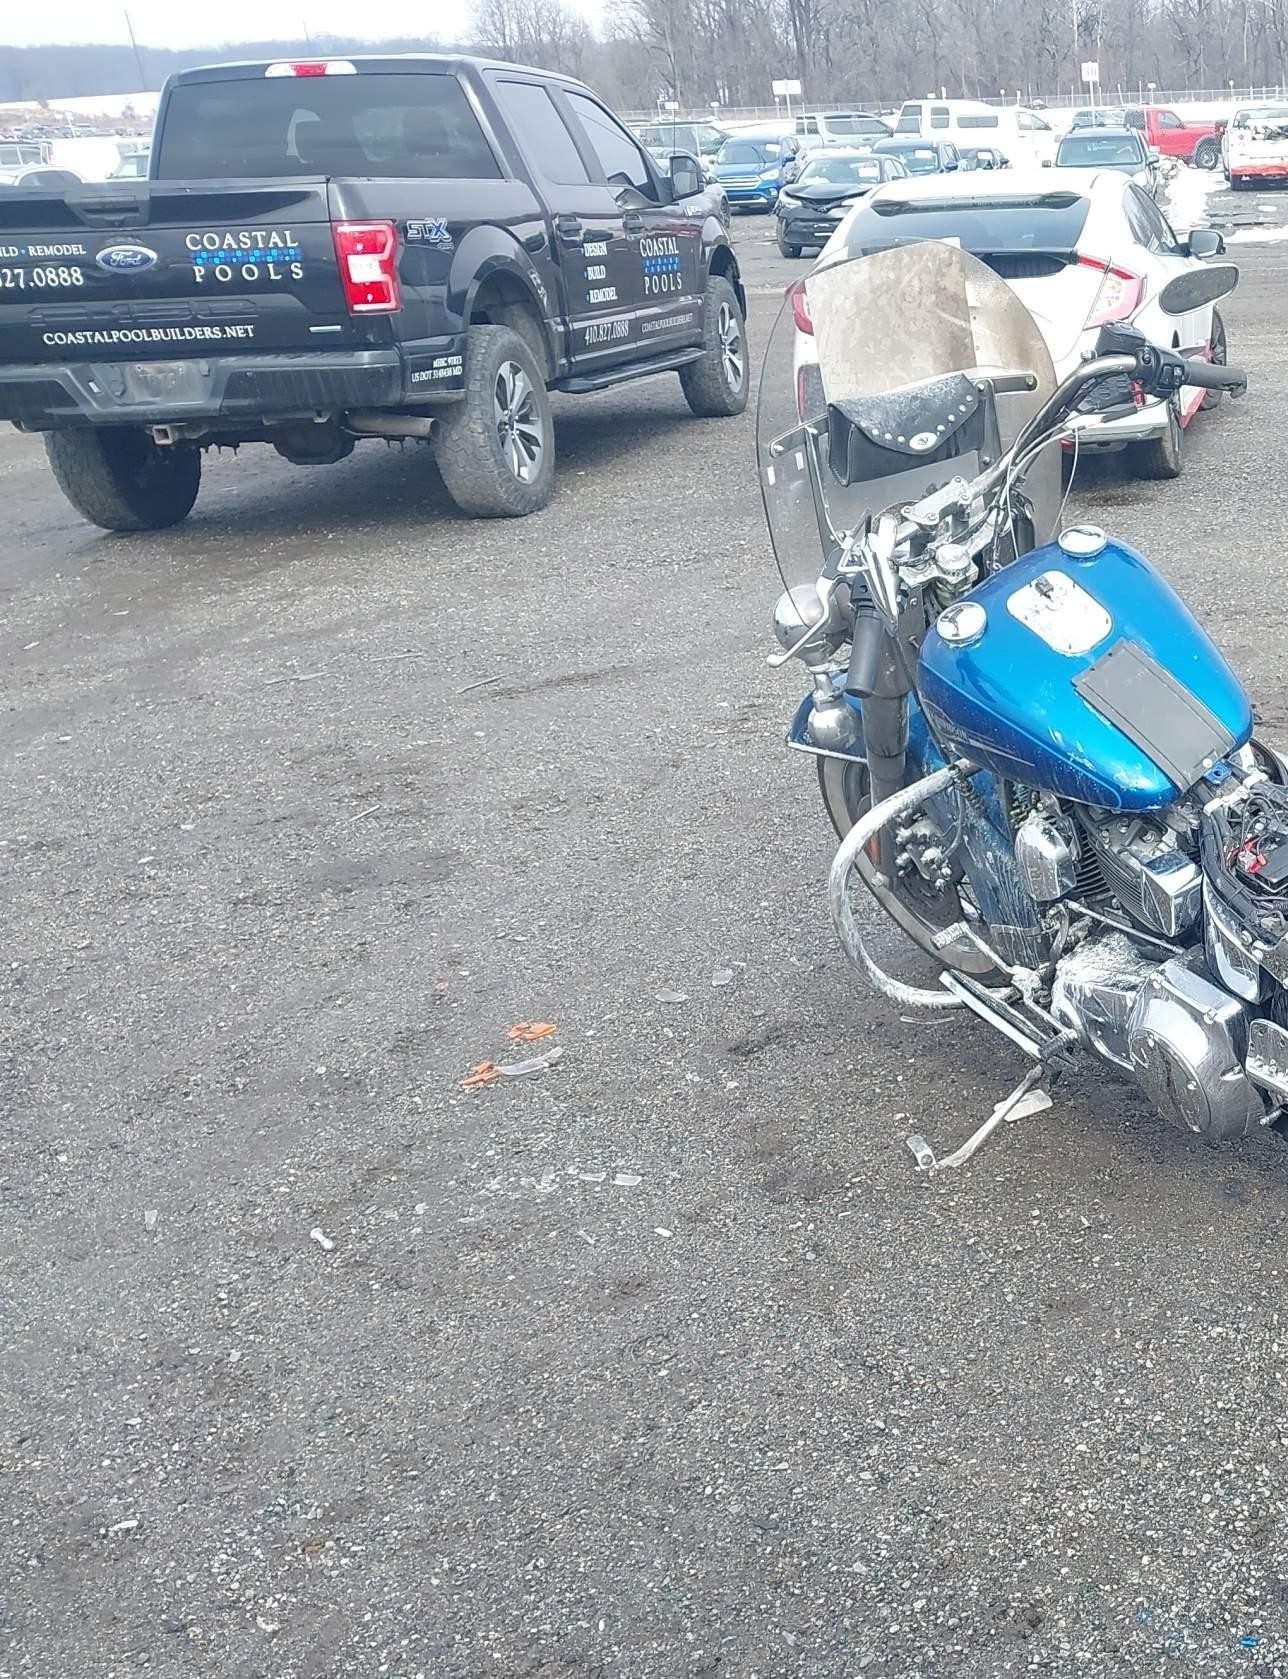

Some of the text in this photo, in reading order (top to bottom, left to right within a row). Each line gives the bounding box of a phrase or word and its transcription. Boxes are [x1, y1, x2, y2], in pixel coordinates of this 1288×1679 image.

[407, 217, 453, 242] STX
[185, 230, 299, 250] COASTAL
[583, 241, 608, 257] DESIGN
[640, 236, 680, 257] COASTAL
[28, 244, 87, 257] REMODEL
[110, 251, 143, 267] Ford
[0, 267, 84, 289] 27.0888
[193, 262, 304, 282] POOLS
[587, 265, 607, 280] BUILD
[644, 272, 682, 295] POOLS
[588, 286, 618, 304] REMODEL
[43, 325, 255, 345] COASTALPOOLBUILDERS.NET
[584, 319, 629, 346] 410.827.0888
[411, 371, 420, 383] US
[419, 370, 432, 381] DOT
